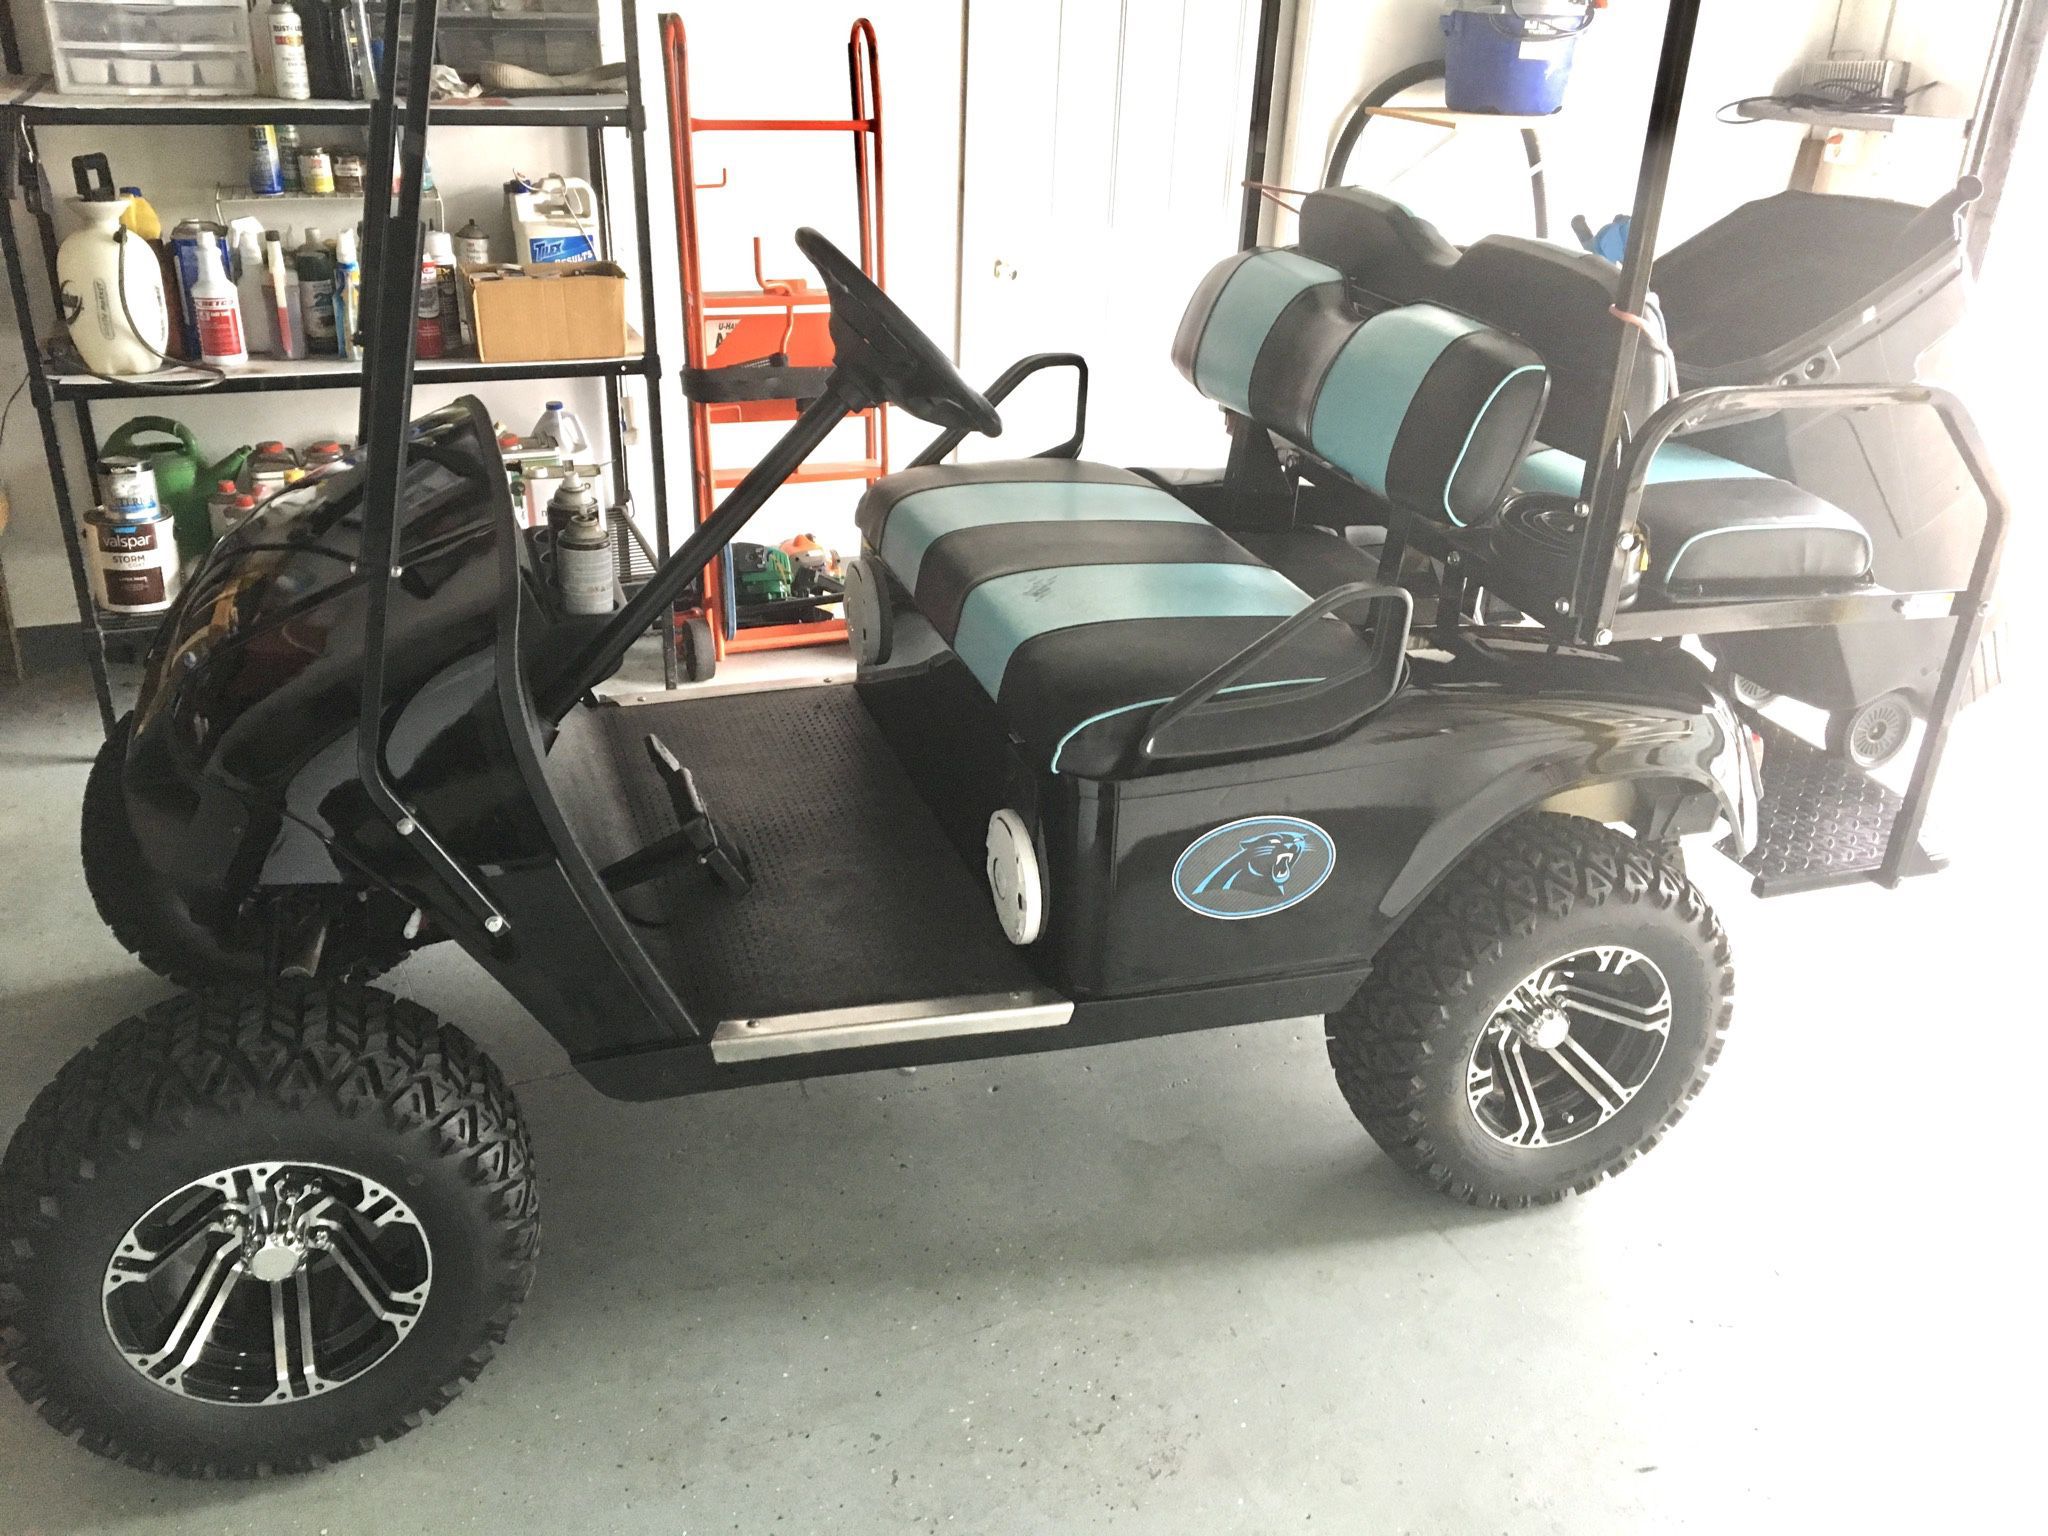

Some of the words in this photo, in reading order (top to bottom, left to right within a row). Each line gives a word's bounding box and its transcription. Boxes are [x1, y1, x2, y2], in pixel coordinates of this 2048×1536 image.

[534, 240, 563, 260] TILEX
[718, 322, 736, 331] U-HA
[103, 534, 152, 550] valspar
[112, 554, 145, 564] STORM
